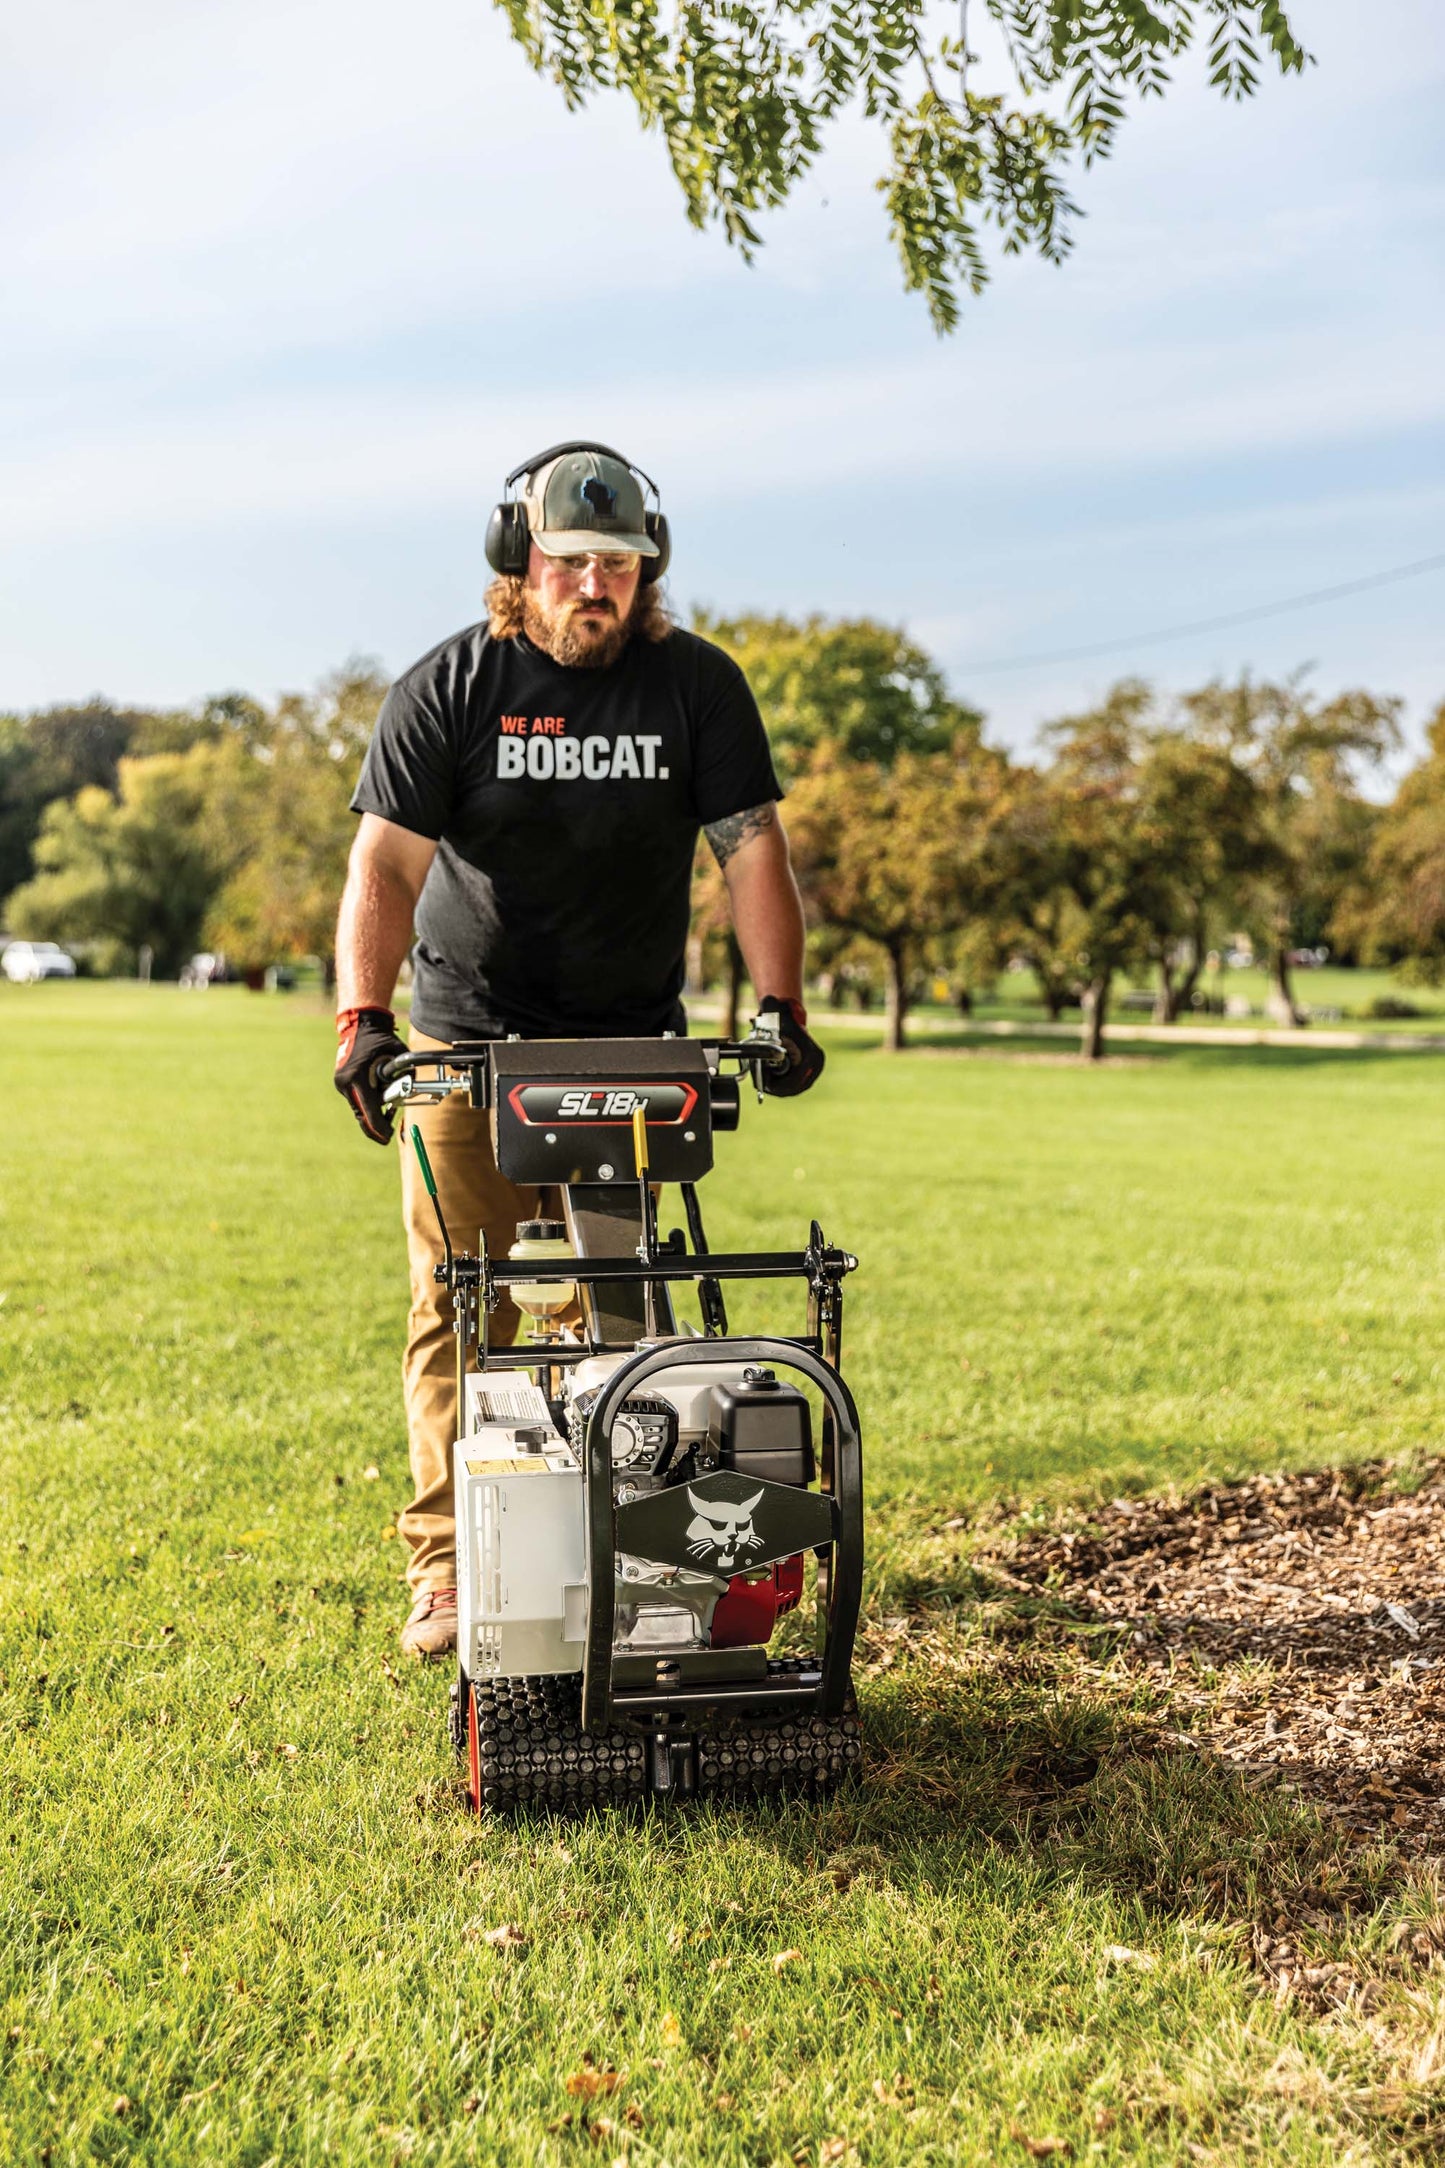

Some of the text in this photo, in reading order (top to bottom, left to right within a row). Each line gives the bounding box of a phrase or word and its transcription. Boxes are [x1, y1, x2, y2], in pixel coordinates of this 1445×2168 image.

[501, 715, 565, 736] WE ARE
[497, 734, 670, 781] BOBCAT.
